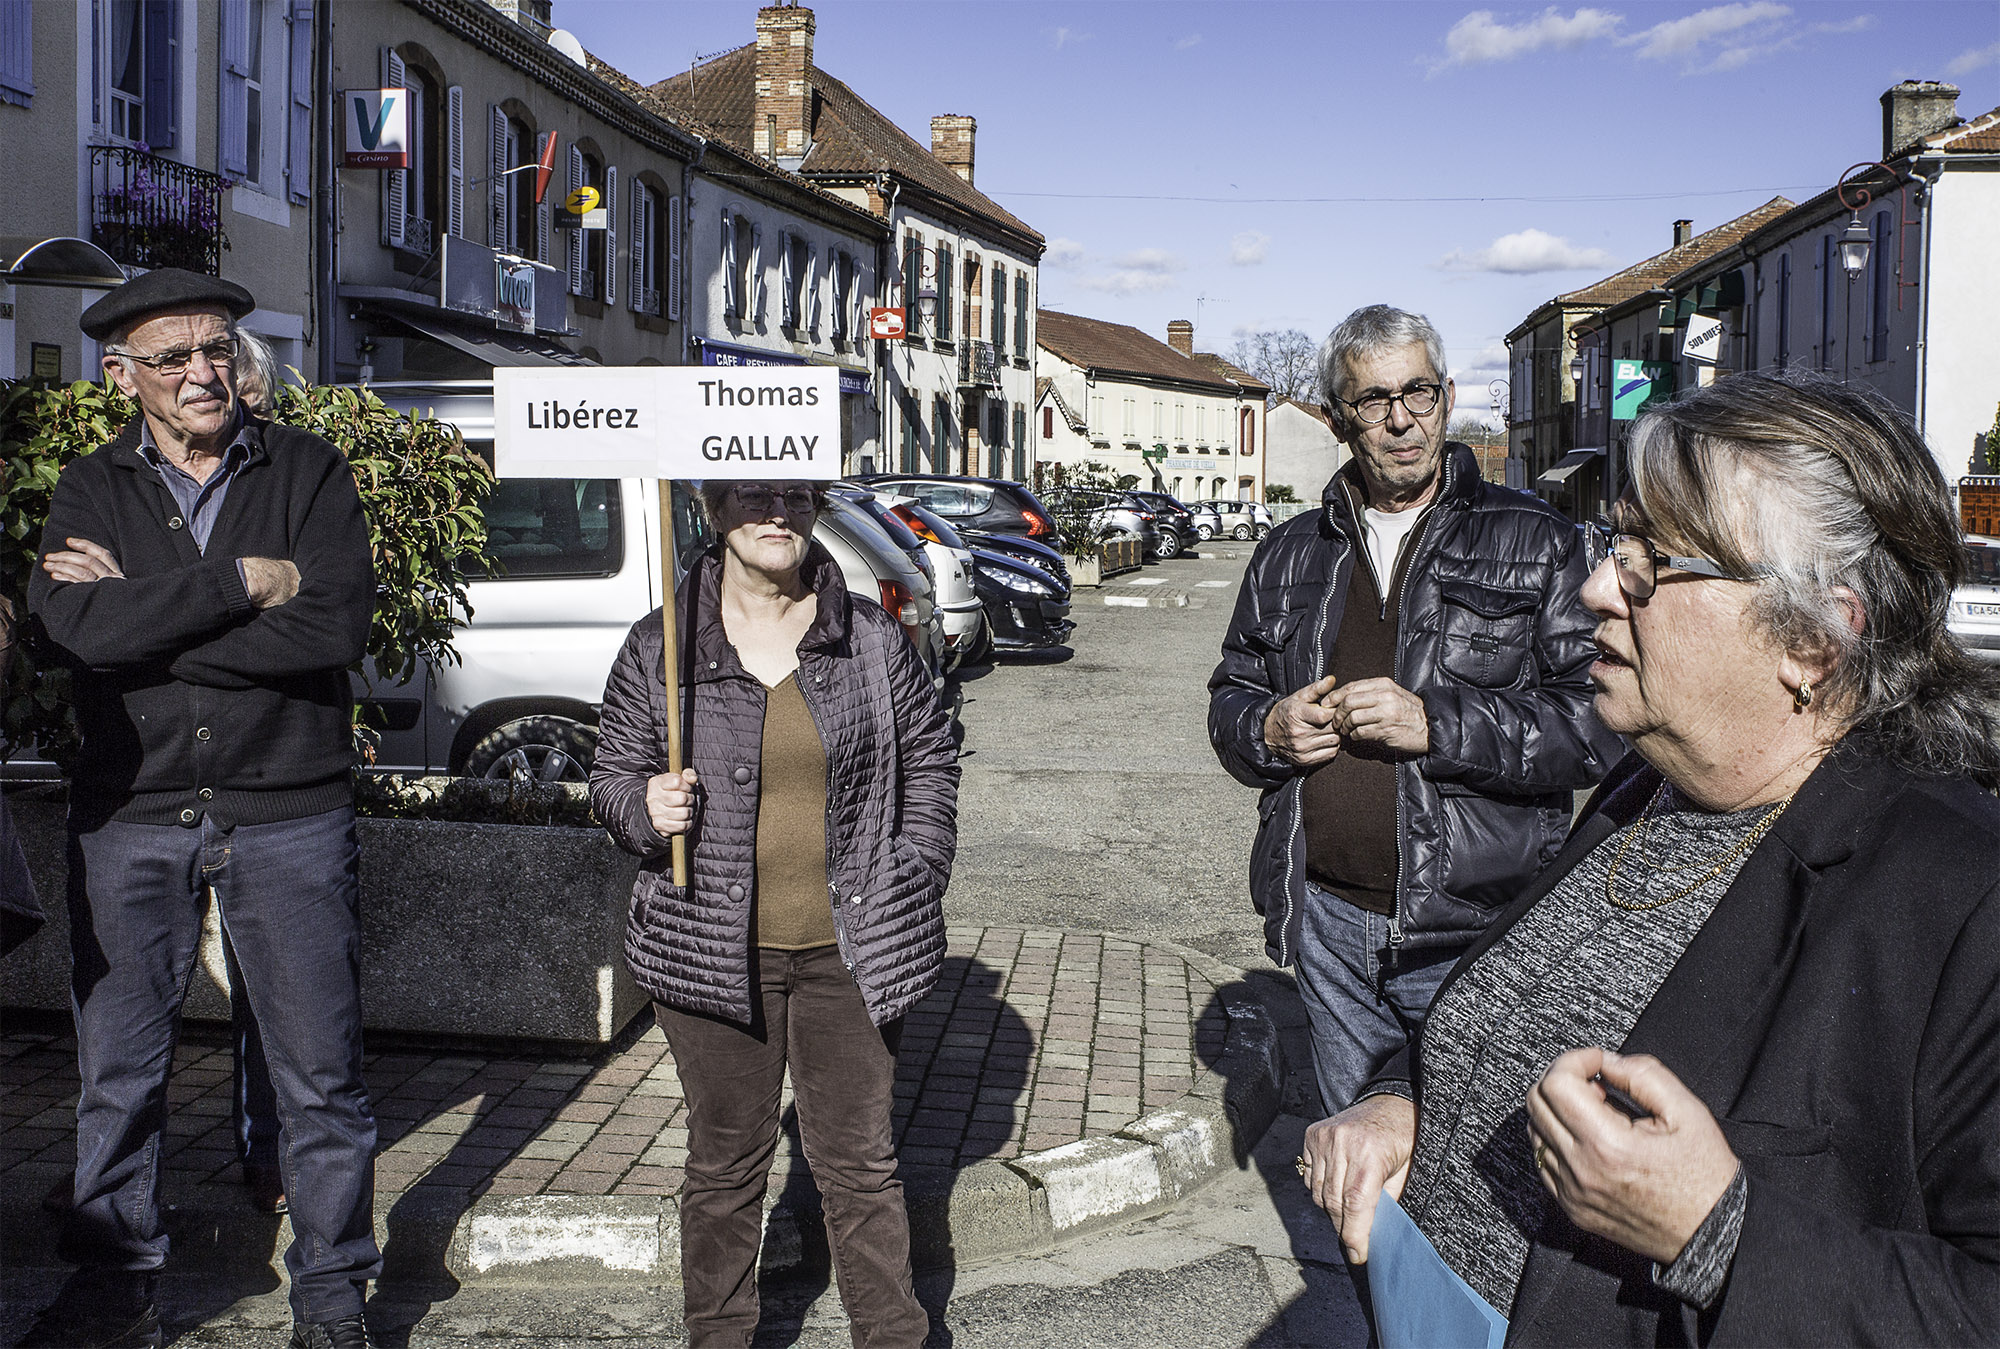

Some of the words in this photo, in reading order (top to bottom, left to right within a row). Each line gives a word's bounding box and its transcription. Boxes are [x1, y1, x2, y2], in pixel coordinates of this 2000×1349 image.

[353, 97, 396, 151] V
[357, 153, 389, 164] Casino
[1688, 336, 1704, 349] SUD
[1703, 323, 1726, 341] OUEST
[716, 353, 738, 367] CAFE
[1617, 363, 1661, 380] ELAN
[698, 380, 819, 406] Thomas
[527, 400, 639, 429] Libérez
[701, 435, 819, 461] GALLAY
